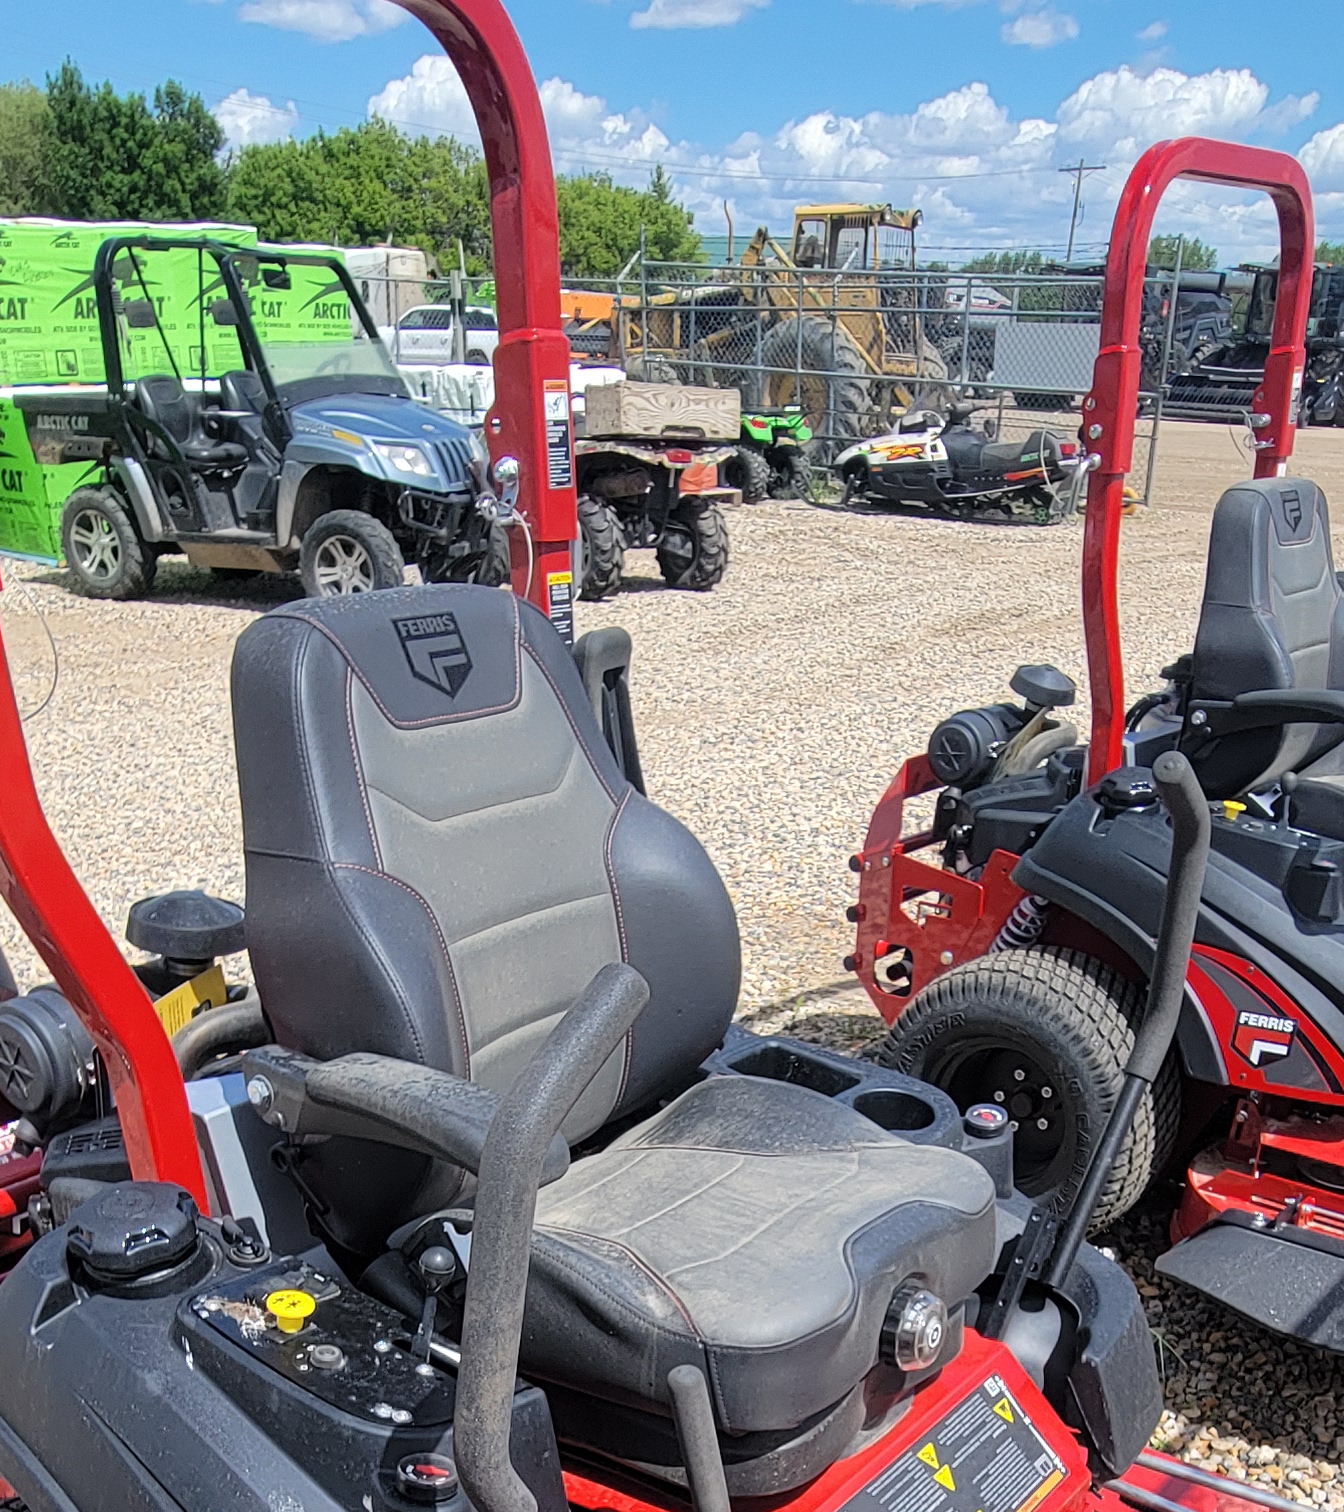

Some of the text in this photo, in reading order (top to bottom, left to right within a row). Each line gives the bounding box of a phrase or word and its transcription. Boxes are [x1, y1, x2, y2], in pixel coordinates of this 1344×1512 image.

[1, 469, 23, 493] CAT
[397, 613, 455, 637] FERRIS
[1239, 1012, 1294, 1032] FERRIS
